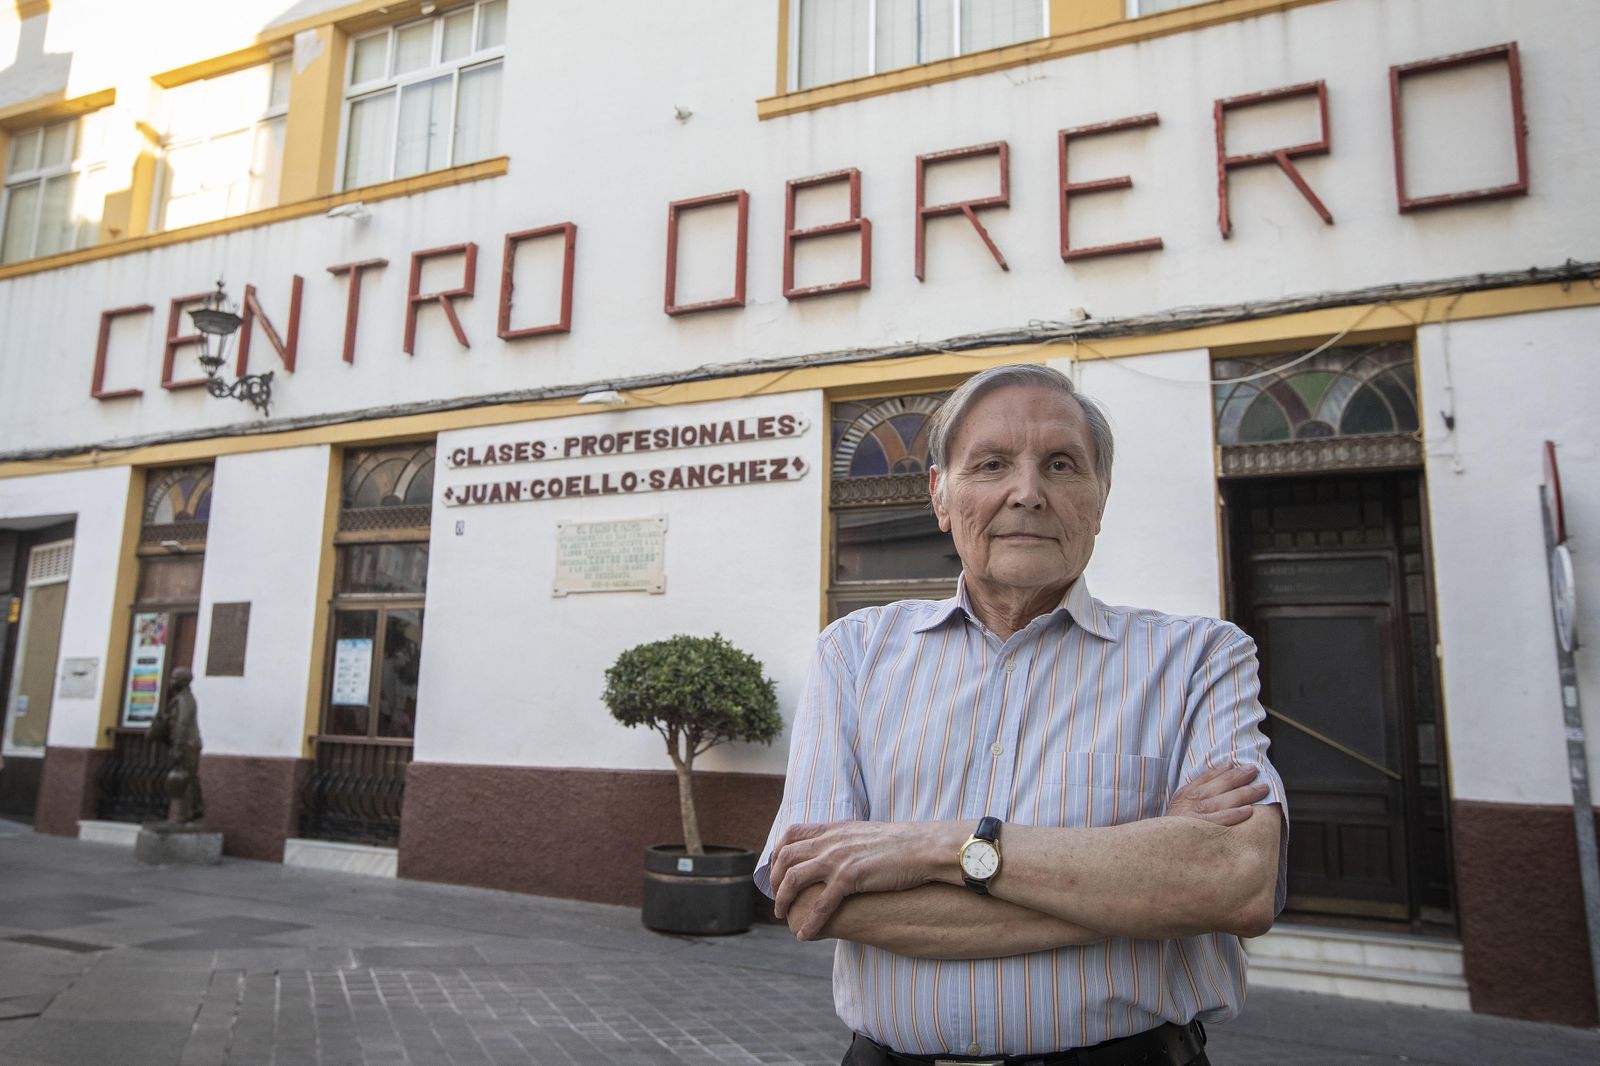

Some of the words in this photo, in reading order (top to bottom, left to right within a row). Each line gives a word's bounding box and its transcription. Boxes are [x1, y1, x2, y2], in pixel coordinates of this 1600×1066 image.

[91, 222, 578, 398] CENTRO
[664, 41, 1527, 316] OBRERO
[452, 441, 546, 466] CLASES
[564, 414, 796, 457] PROFESIONALES
[456, 481, 521, 504] JUAN
[530, 471, 638, 498] COELLO
[649, 457, 789, 489] SANCHEZ
